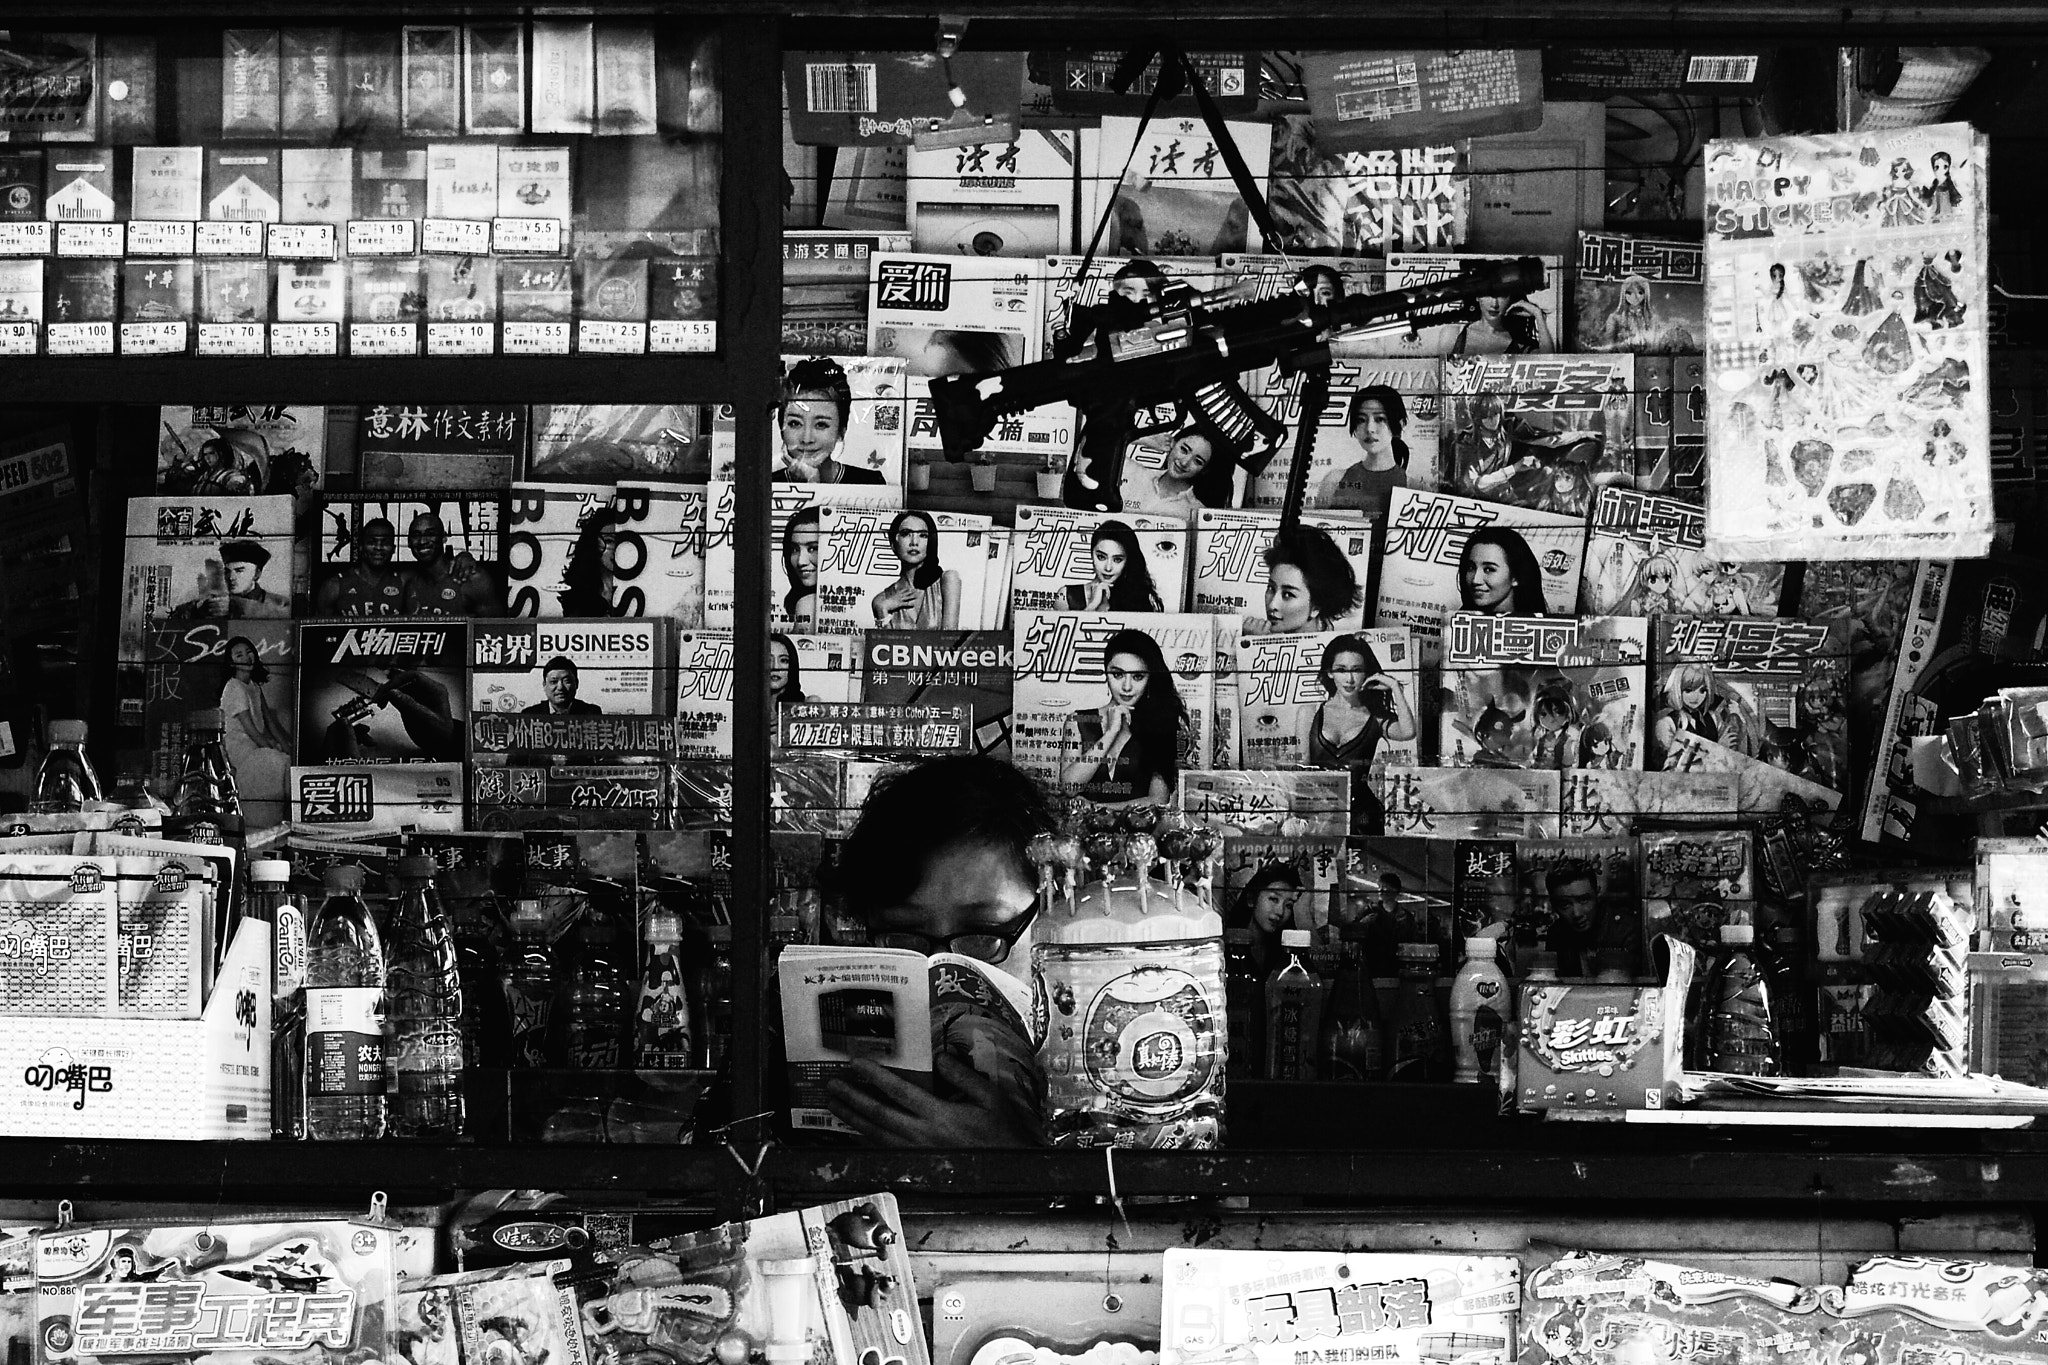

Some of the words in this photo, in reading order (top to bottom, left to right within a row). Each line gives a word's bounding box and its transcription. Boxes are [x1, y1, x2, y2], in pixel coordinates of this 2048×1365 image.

[956, 144, 1022, 174] 读者
[1150, 138, 1221, 177] 读者
[1715, 174, 1812, 202] HAPPY
[57, 198, 102, 218] Marlboro
[1714, 199, 1855, 234] STICKER
[881, 264, 947, 303] 爱你
[1052, 428, 1068, 445] 10
[330, 628, 447, 664] 人物周刊
[475, 633, 536, 665] 商界
[539, 633, 650, 653] BUSINESS
[1014, 615, 1126, 683] 知音
[871, 671, 979, 687] 第一财经周刊
[303, 776, 369, 816] 爱你
[1547, 1015, 1635, 1050] 彩虹
[1560, 1048, 1613, 1066] Skittles
[1245, 1280, 1430, 1344] 玩具部落
[1185, 1334, 1204, 1346] GAS
[1292, 1344, 1399, 1365] 加入我们的团队
